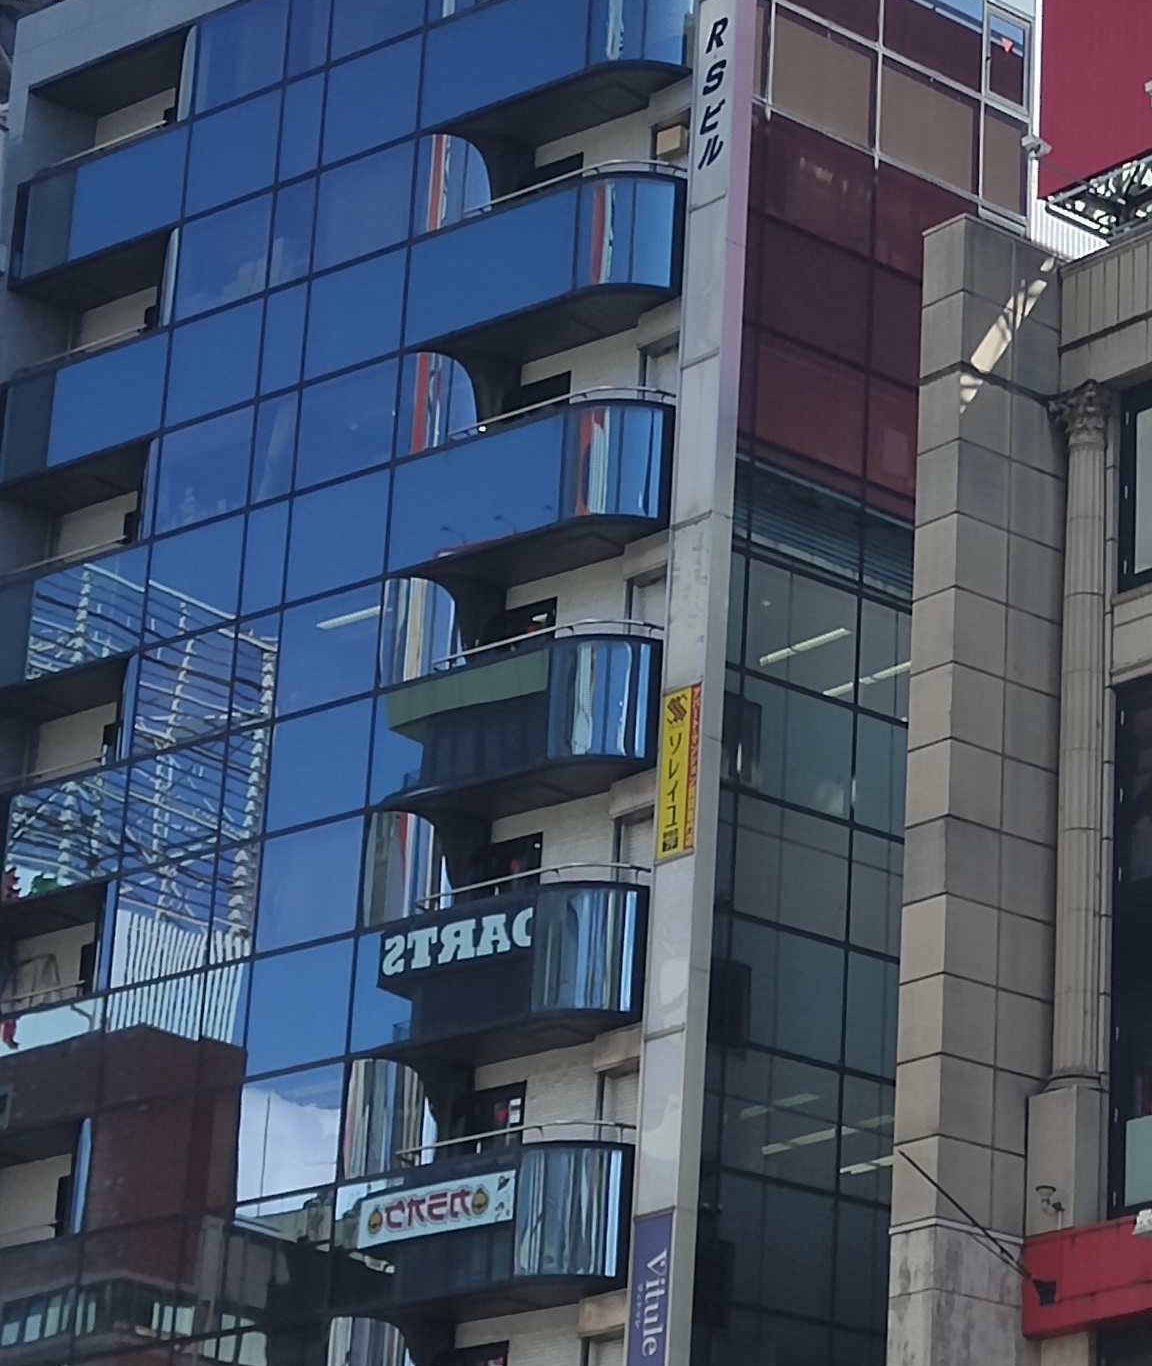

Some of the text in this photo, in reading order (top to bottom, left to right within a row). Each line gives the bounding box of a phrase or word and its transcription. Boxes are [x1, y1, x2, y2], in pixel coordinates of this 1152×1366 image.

[664, 733, 683, 829] ソレイユ
[641, 1248, 668, 1357] Vitule
